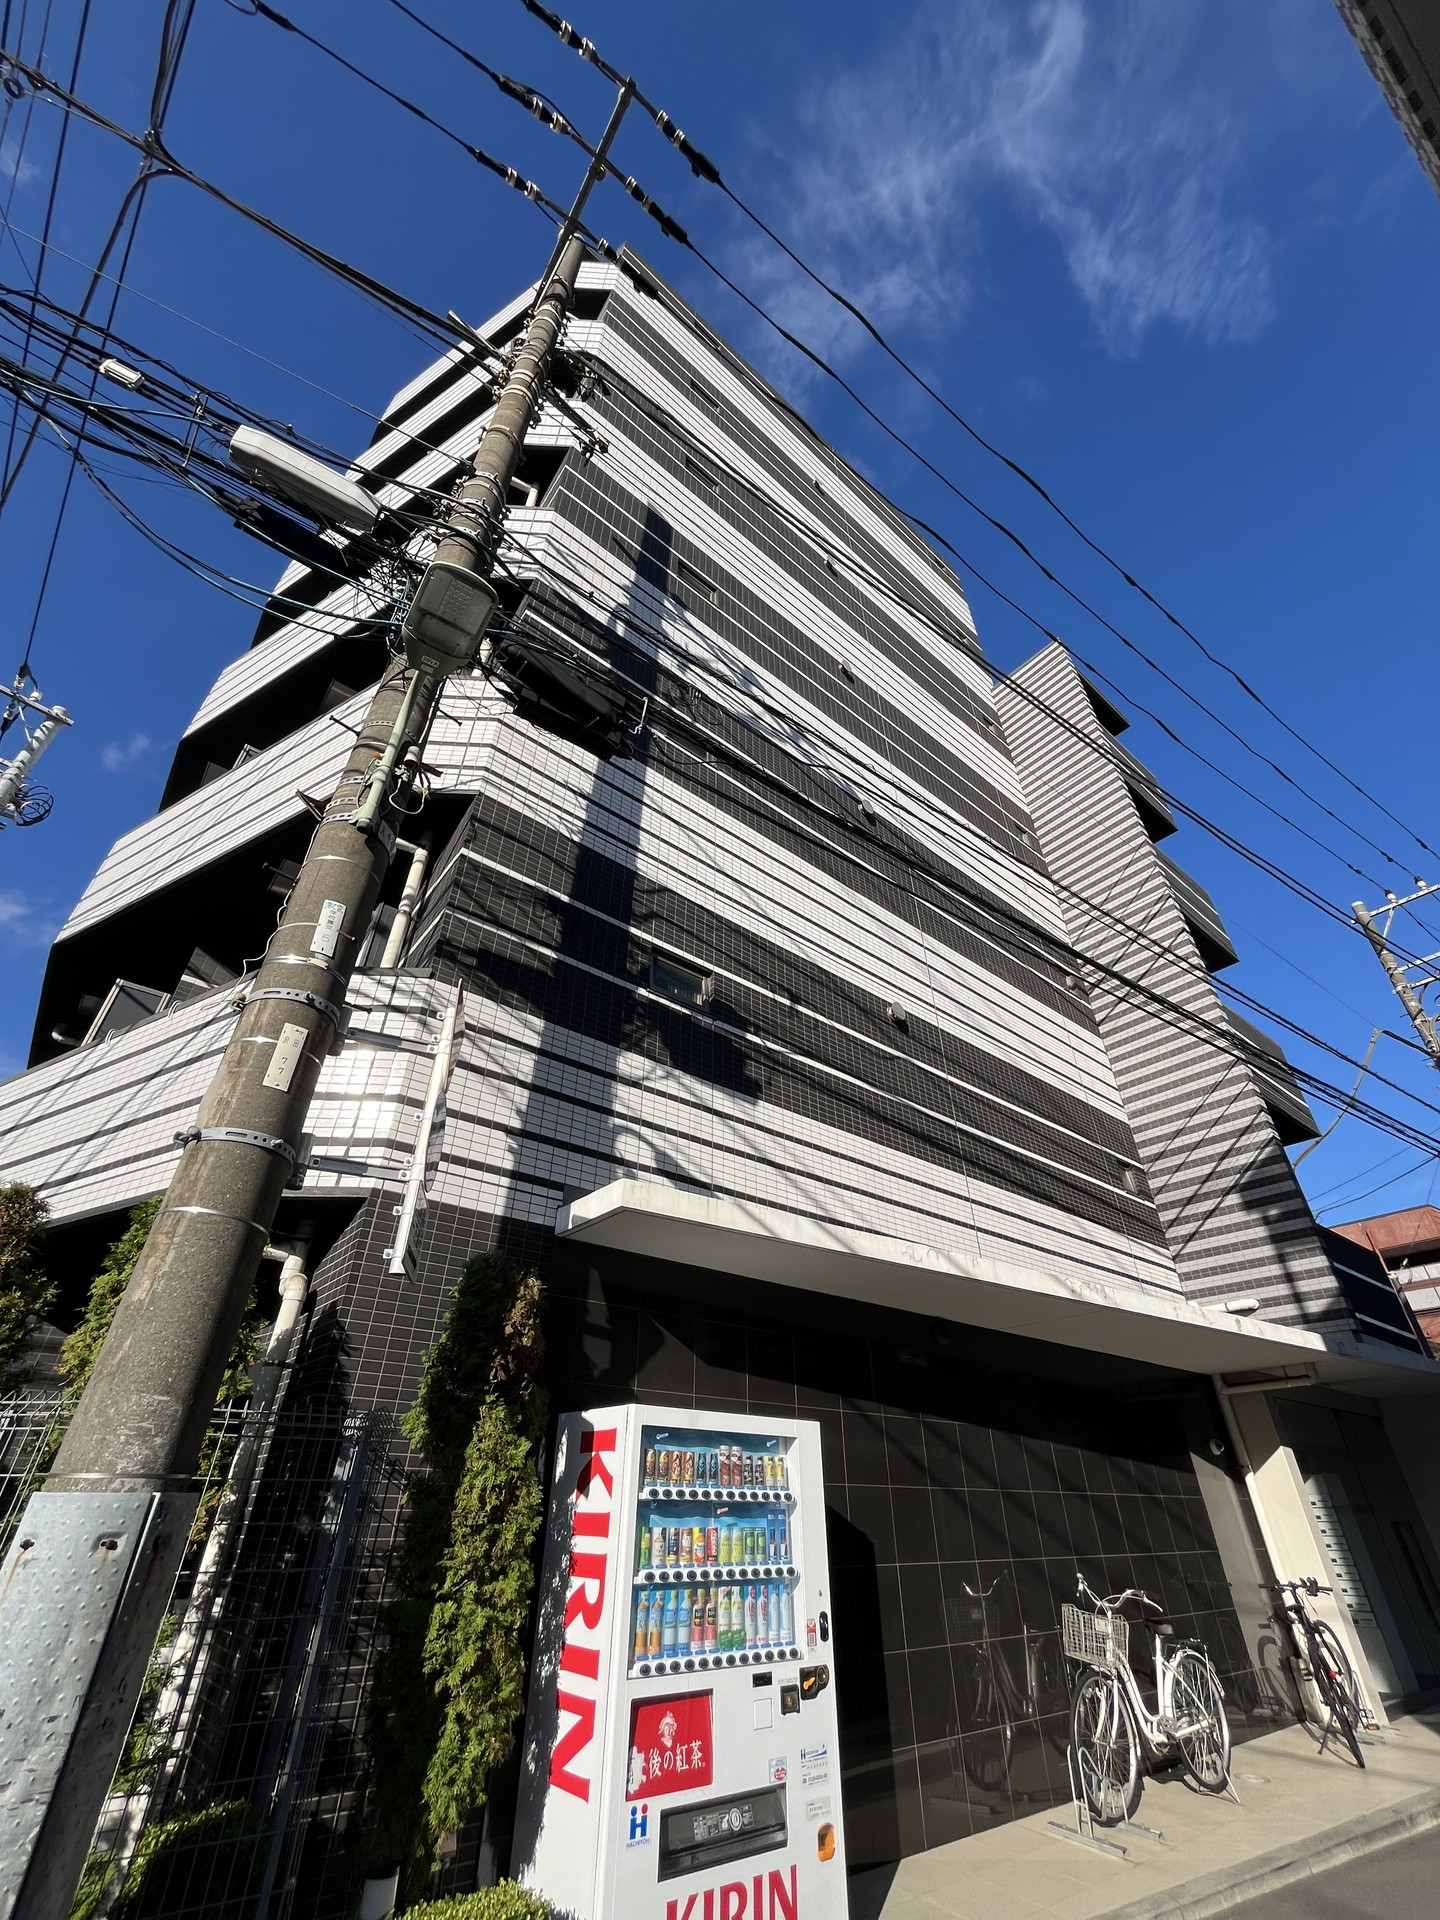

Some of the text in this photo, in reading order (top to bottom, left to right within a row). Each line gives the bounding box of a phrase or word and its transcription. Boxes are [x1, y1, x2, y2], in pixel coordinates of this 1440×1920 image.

[548, 1427, 617, 1803] KIRIN
[643, 1740, 703, 1780] 後の紅茶
